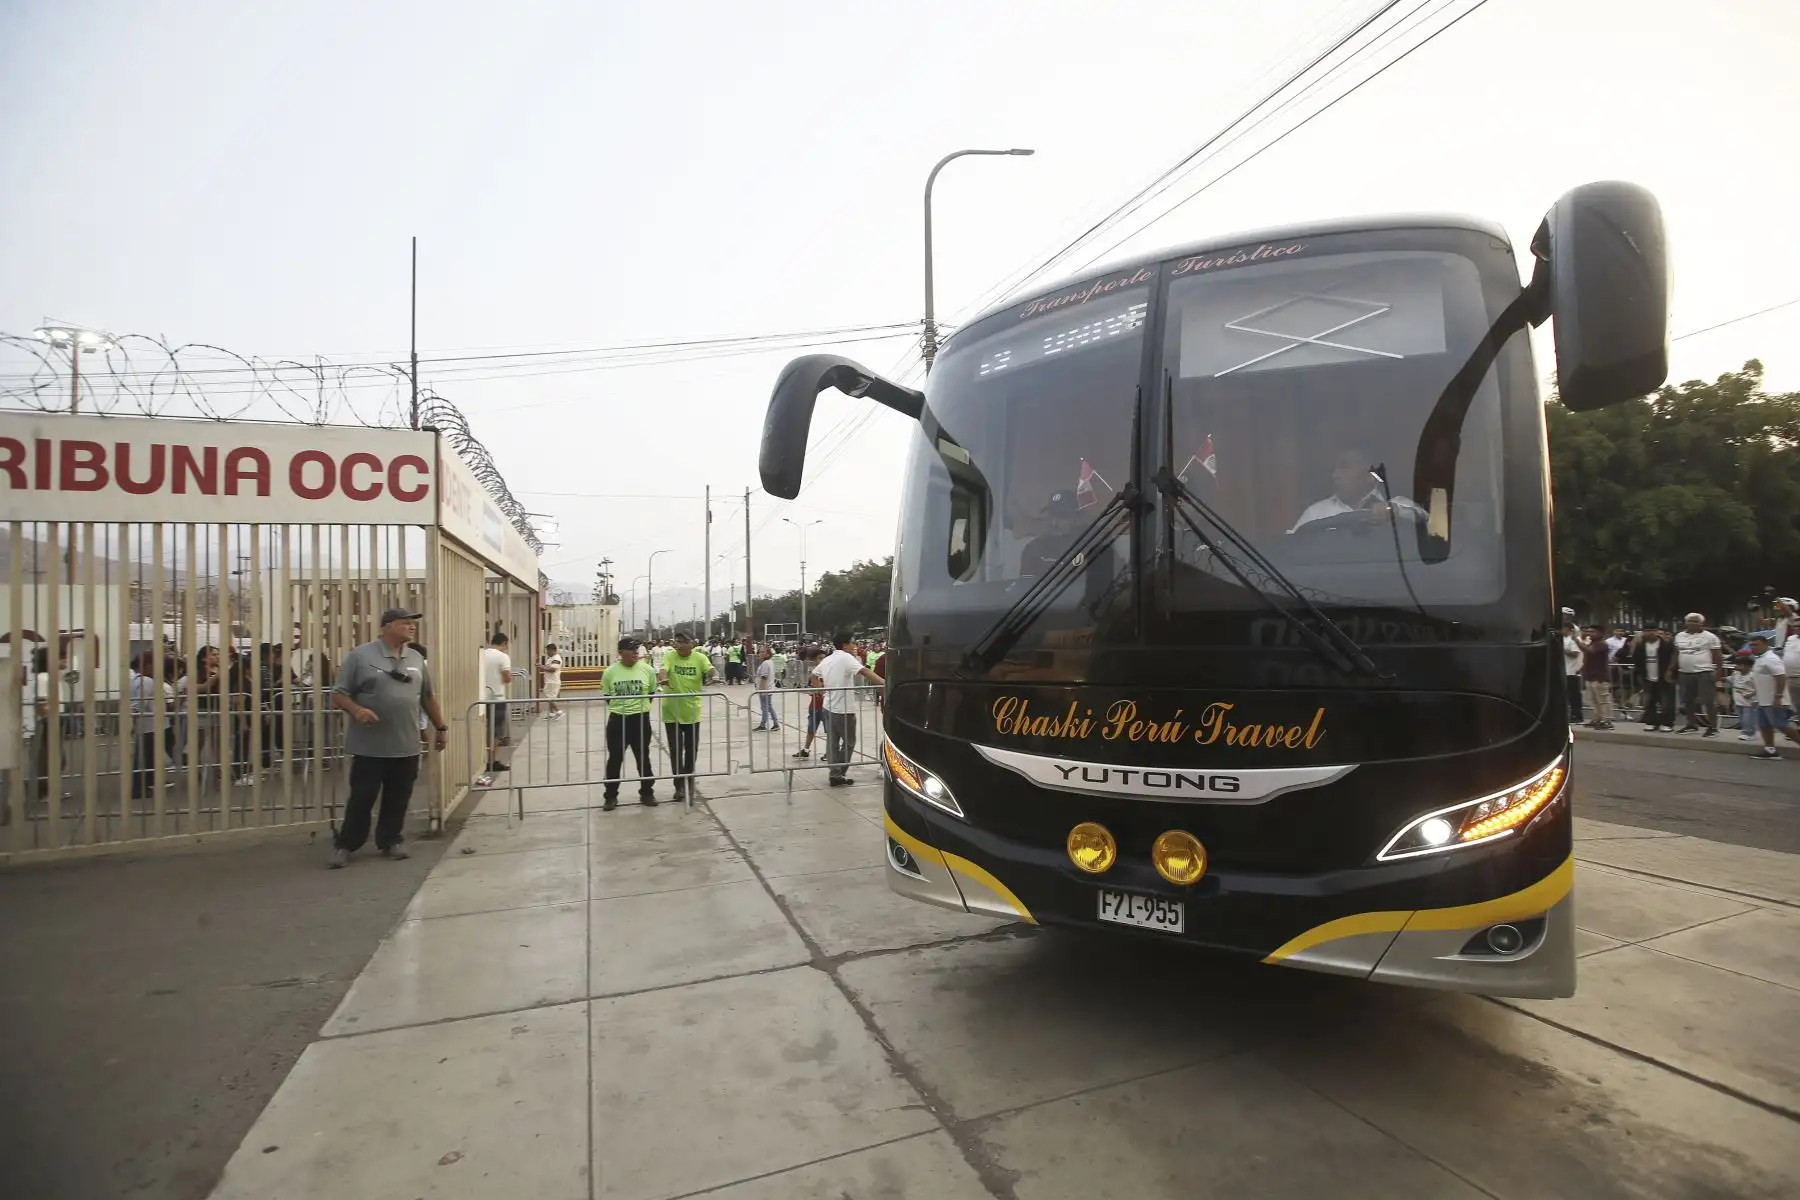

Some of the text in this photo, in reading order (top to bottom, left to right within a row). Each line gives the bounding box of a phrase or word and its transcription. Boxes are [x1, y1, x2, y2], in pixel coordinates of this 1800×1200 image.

[1020, 243, 1308, 319] Transporte Turístico
[288, 450, 430, 503] OCC
[992, 696, 1326, 749] Chaski Perú Travel
[1053, 764, 1240, 793] YUTONG
